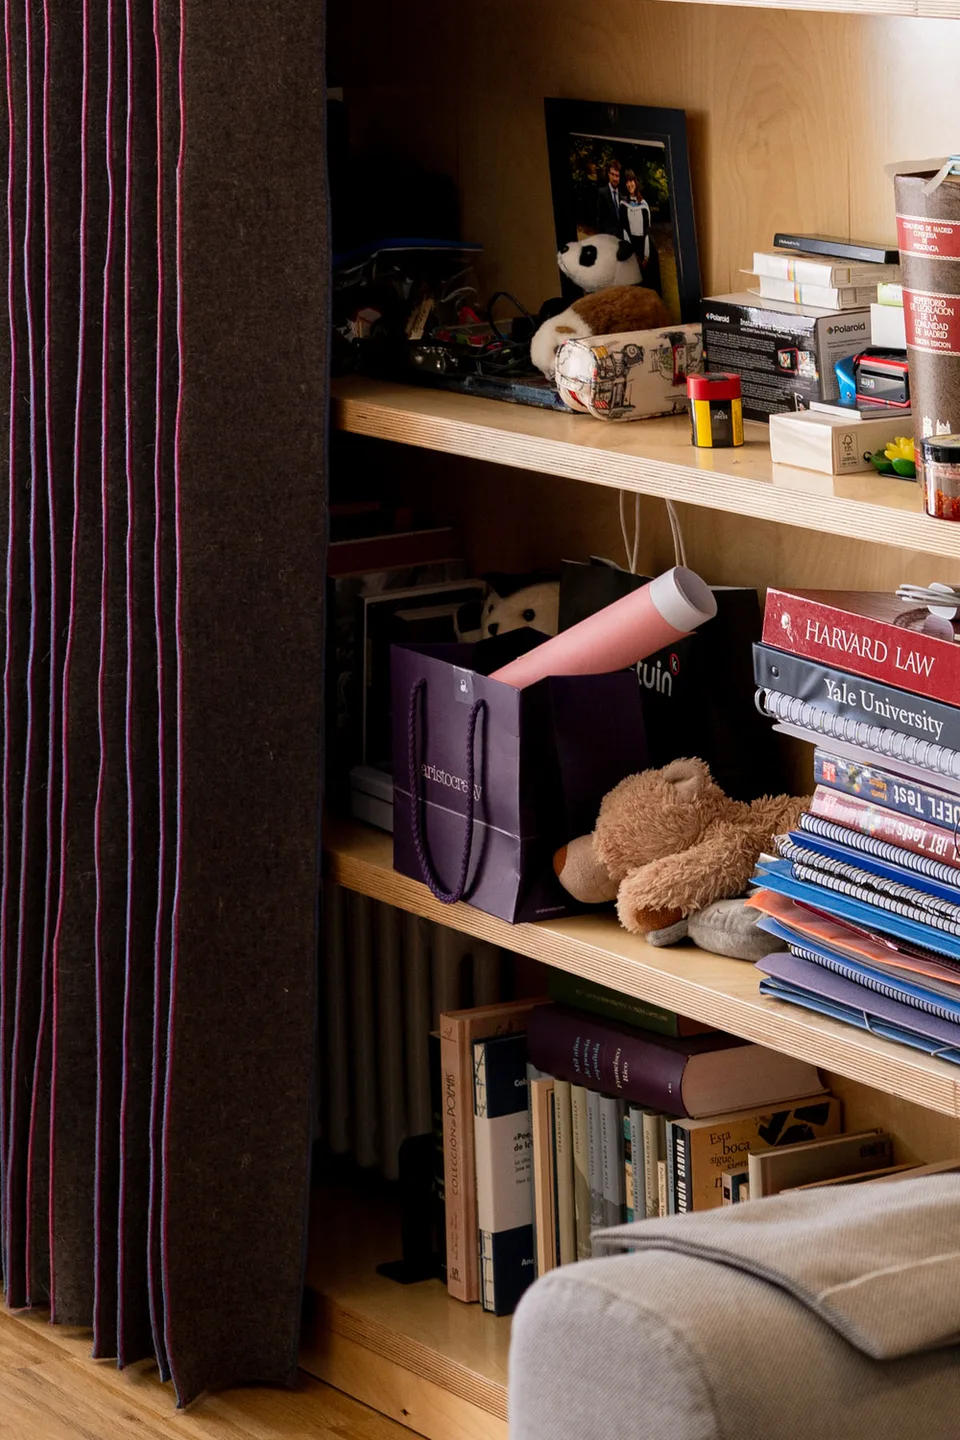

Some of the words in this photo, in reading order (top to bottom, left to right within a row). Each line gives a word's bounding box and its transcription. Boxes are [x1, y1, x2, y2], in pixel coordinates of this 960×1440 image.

[902, 222, 924, 230] COMUNIDAD
[932, 226, 953, 234] MADRID
[913, 295, 946, 308] REPERTORIO
[709, 313, 730, 323] Polaroid
[918, 304, 954, 316] LEGISLACION
[920, 312, 928, 320] DE
[929, 314, 938, 322] LA
[834, 322, 866, 334] Polaroid
[914, 320, 949, 331] COMUNIDAD
[924, 329, 948, 339] MADRID
[930, 339, 952, 348] EDICION
[806, 618, 888, 663] HARVARD
[895, 646, 936, 678] LAW
[824, 678, 856, 706] Yale
[860, 689, 944, 740] University
[420, 763, 482, 801] aristocray
[894, 784, 924, 814] Test
[897, 822, 926, 849] Tests
[928, 832, 949, 856] iBT
[612, 1048, 622, 1089] Francisco
[446, 1072, 457, 1118] POEMAS
[710, 1131, 732, 1146] Esta
[722, 1140, 750, 1156] boca
[450, 1128, 458, 1196] COLECCIÓN
[676, 1139, 686, 1178] SABINA
